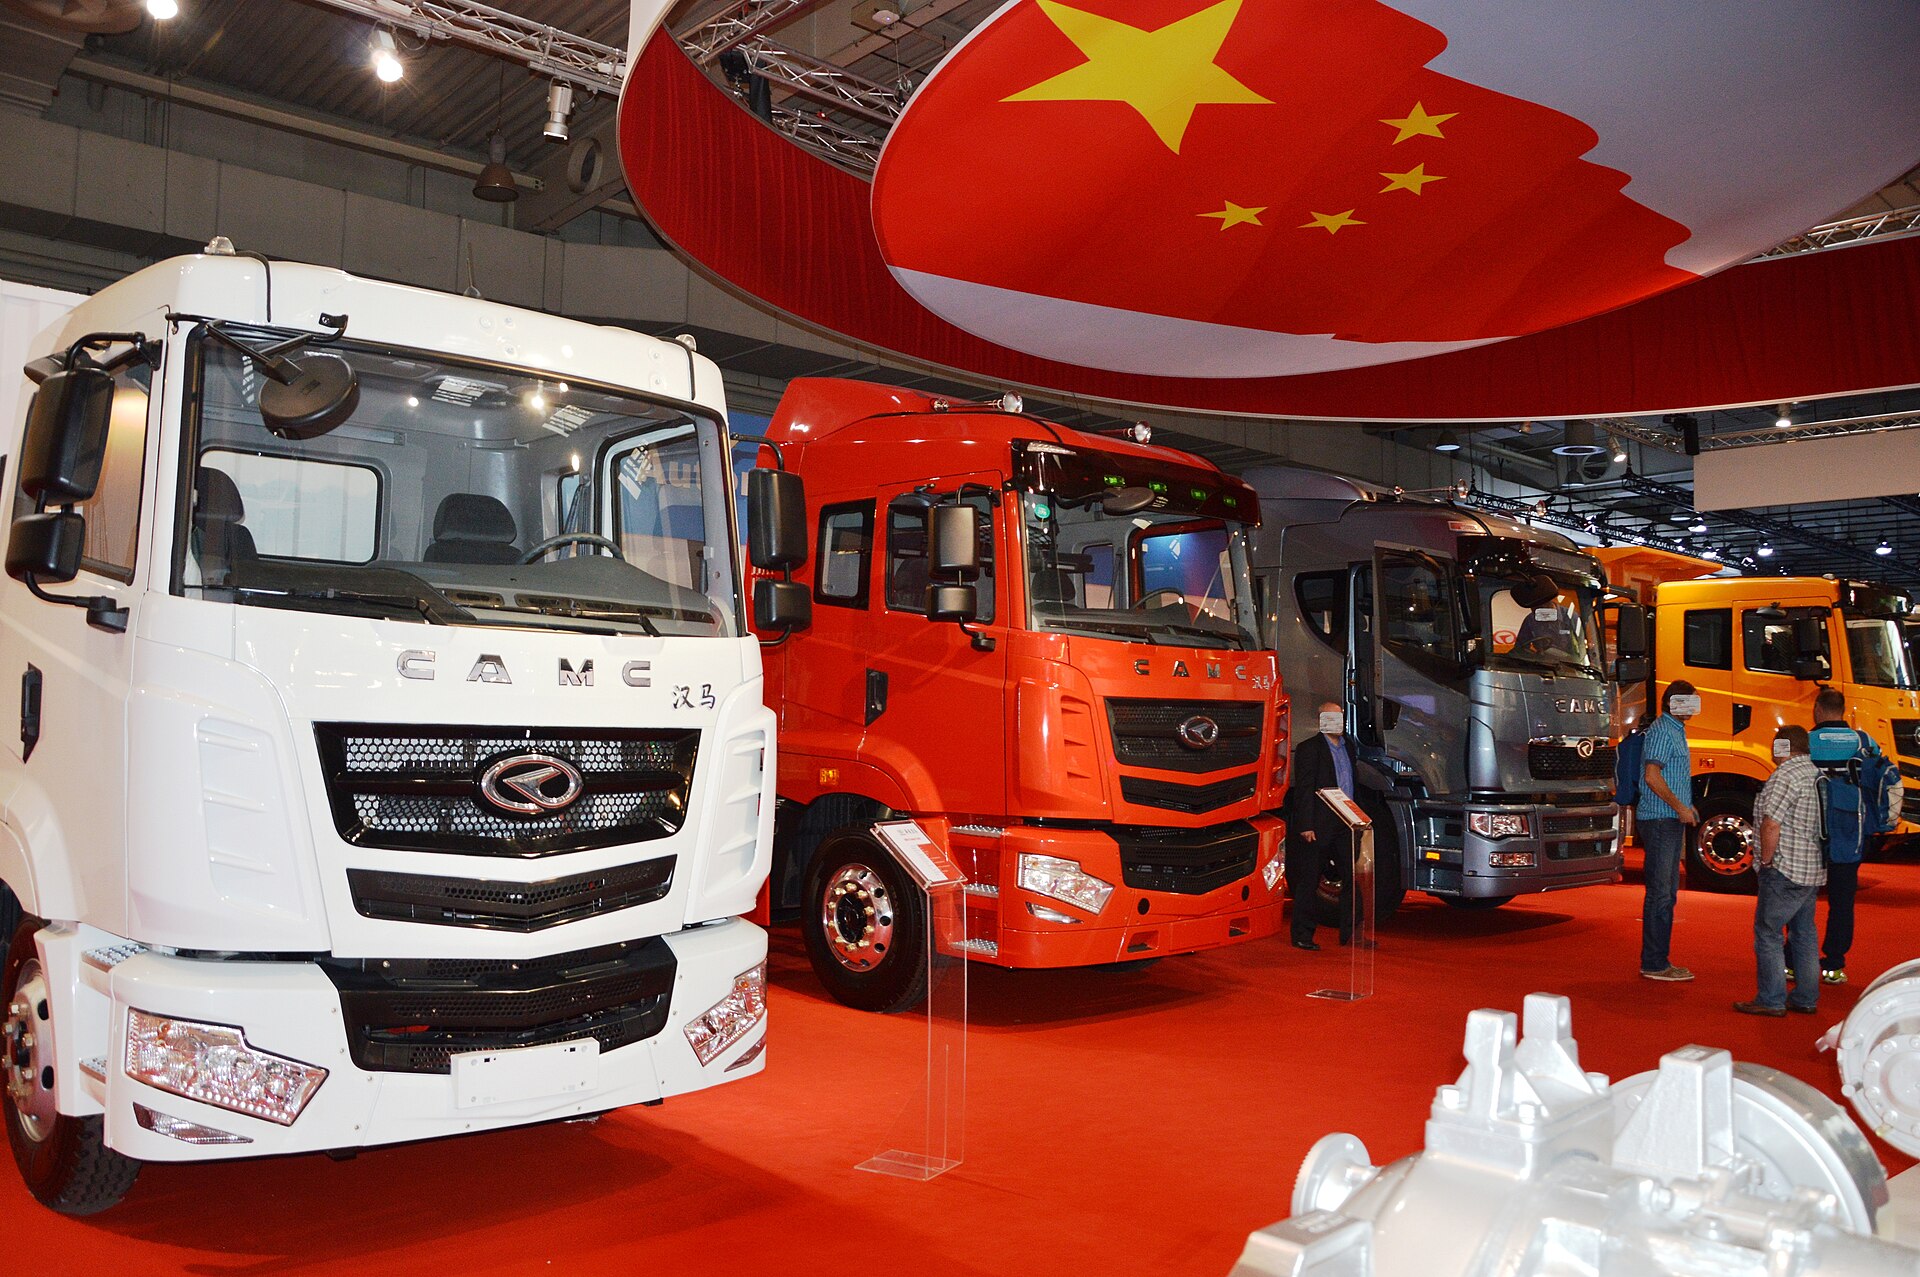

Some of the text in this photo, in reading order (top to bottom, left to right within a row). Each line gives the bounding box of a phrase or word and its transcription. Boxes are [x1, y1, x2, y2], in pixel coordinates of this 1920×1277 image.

[396, 650, 651, 687] CAMC
[1134, 658, 1246, 680] CAMC
[671, 684, 716, 710] 汉马
[1555, 698, 1607, 714] CAMC
